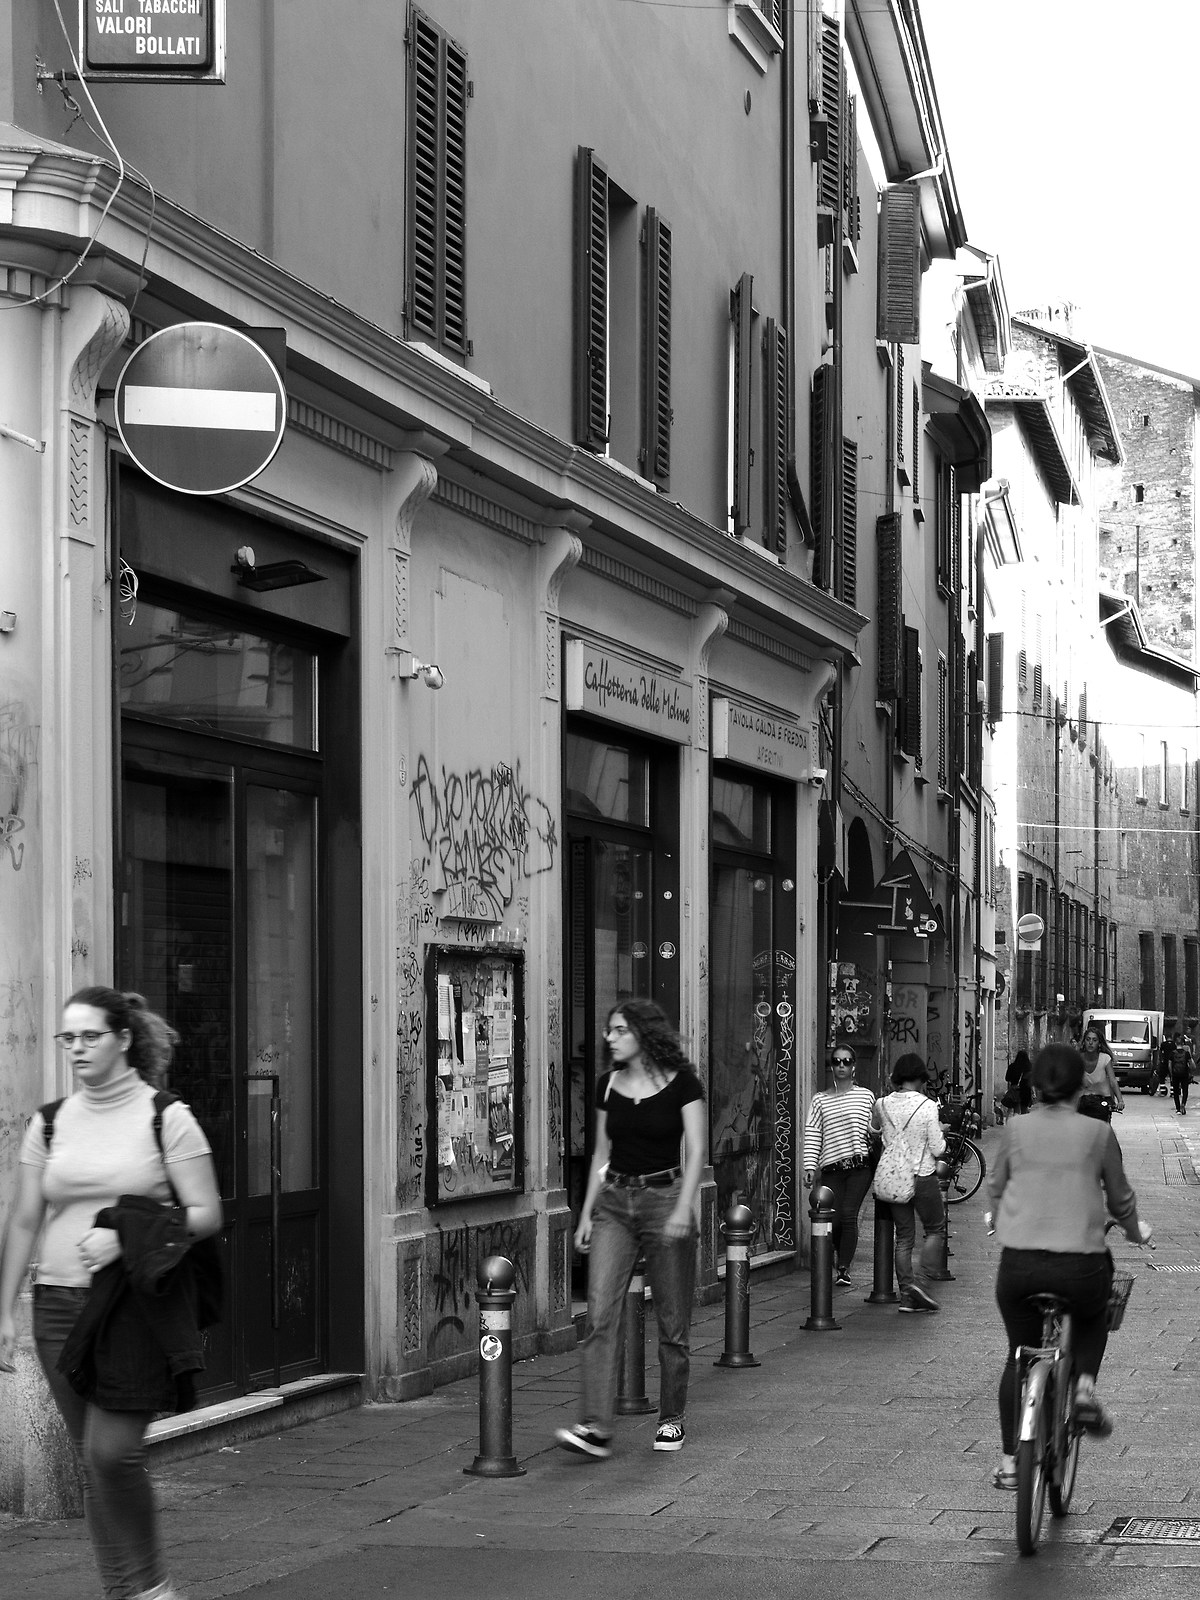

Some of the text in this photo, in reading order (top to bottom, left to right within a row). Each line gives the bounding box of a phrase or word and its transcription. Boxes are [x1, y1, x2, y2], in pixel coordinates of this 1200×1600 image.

[96, 0, 200, 14] SALI TABACCHI
[96, 16, 152, 34] VALORI
[135, 36, 200, 55] BOLLATI
[585, 658, 690, 724] Caffetteria delle Moline
[729, 708, 754, 730] TAVOLA
[755, 718, 776, 739] CALDA
[784, 728, 807, 749] FREDDA
